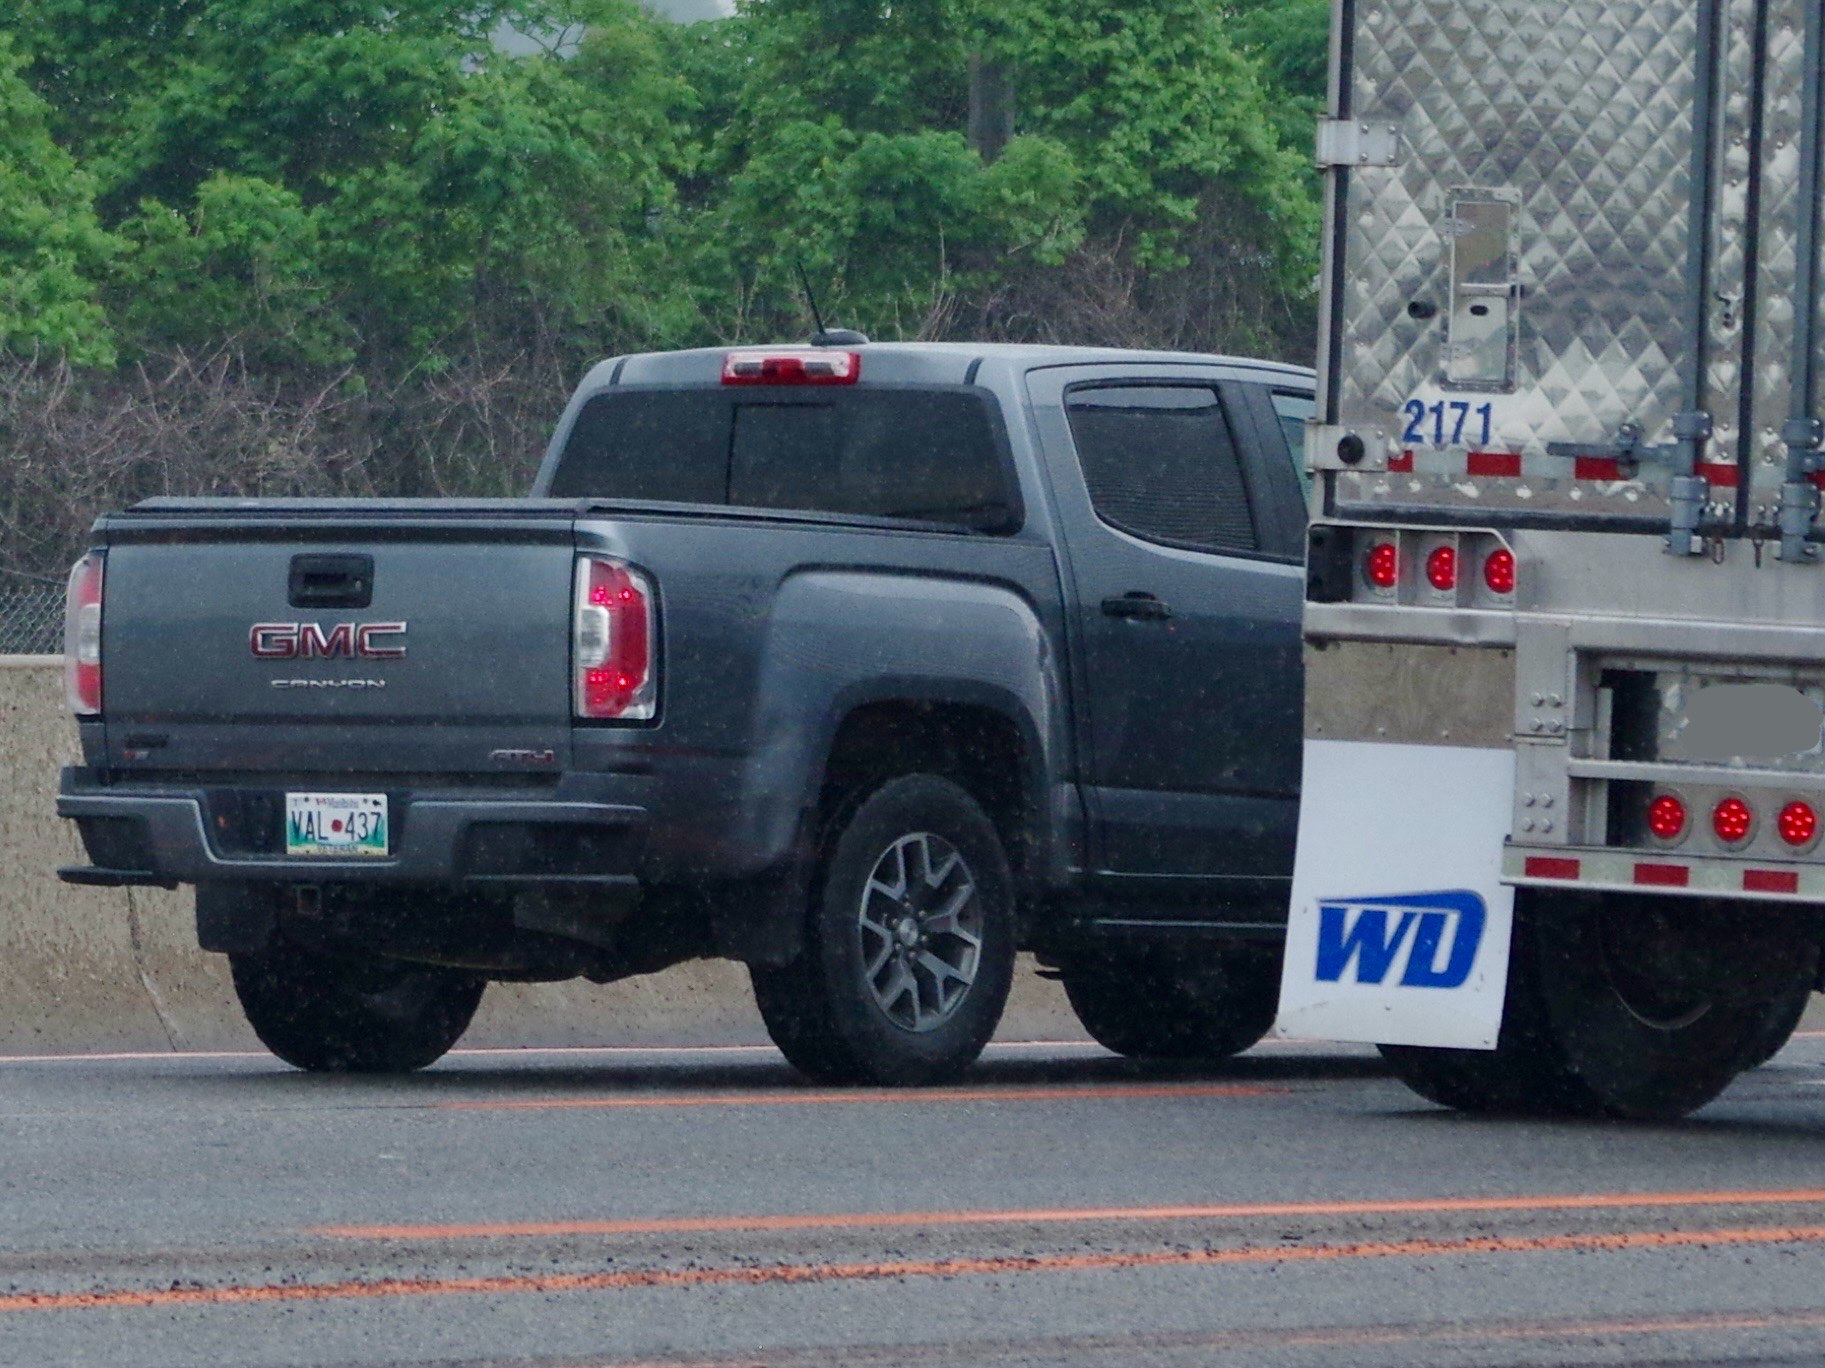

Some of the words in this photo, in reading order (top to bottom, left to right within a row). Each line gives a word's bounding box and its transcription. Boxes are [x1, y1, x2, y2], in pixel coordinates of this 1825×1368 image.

[1402, 398, 1493, 446] 2171
[249, 622, 407, 659] GMC
[269, 678, 387, 690] CANYON
[291, 810, 329, 841] VAL
[345, 811, 382, 841] 437
[1314, 888, 1488, 989] WD
